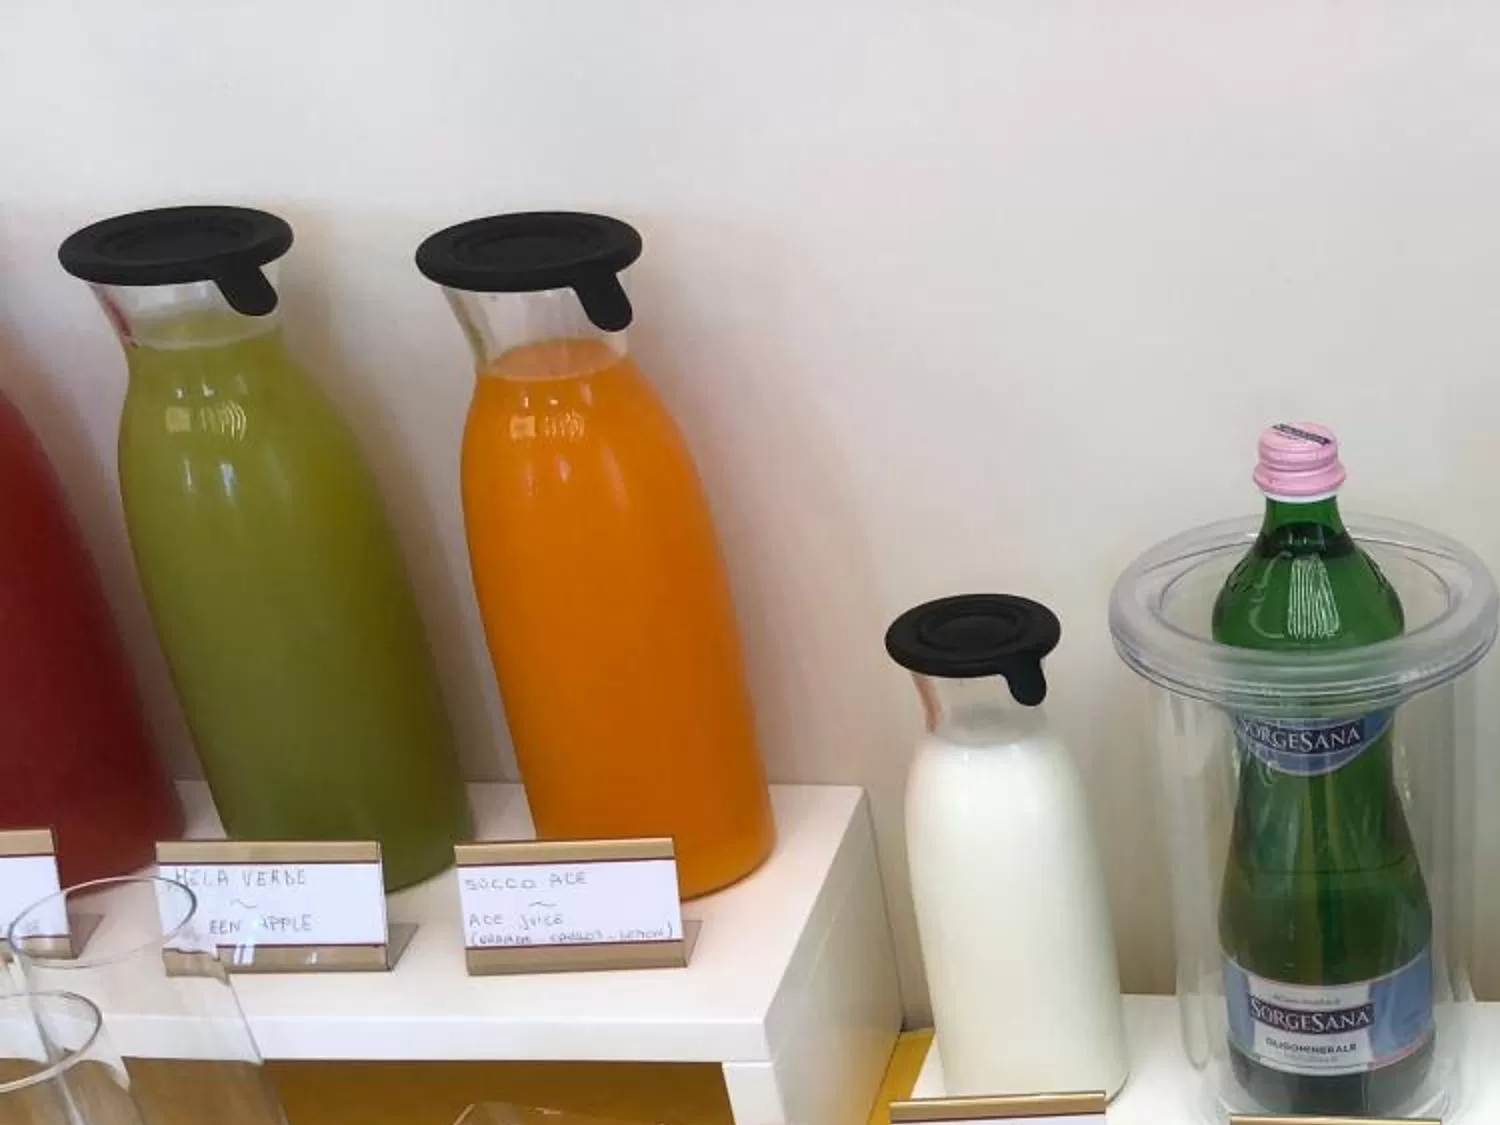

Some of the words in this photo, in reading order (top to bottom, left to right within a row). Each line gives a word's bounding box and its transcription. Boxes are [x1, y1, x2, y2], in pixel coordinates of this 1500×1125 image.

[242, 868, 306, 888] VERDE
[549, 871, 589, 888] ACE
[1250, 1000, 1370, 1034] SORGESANA
